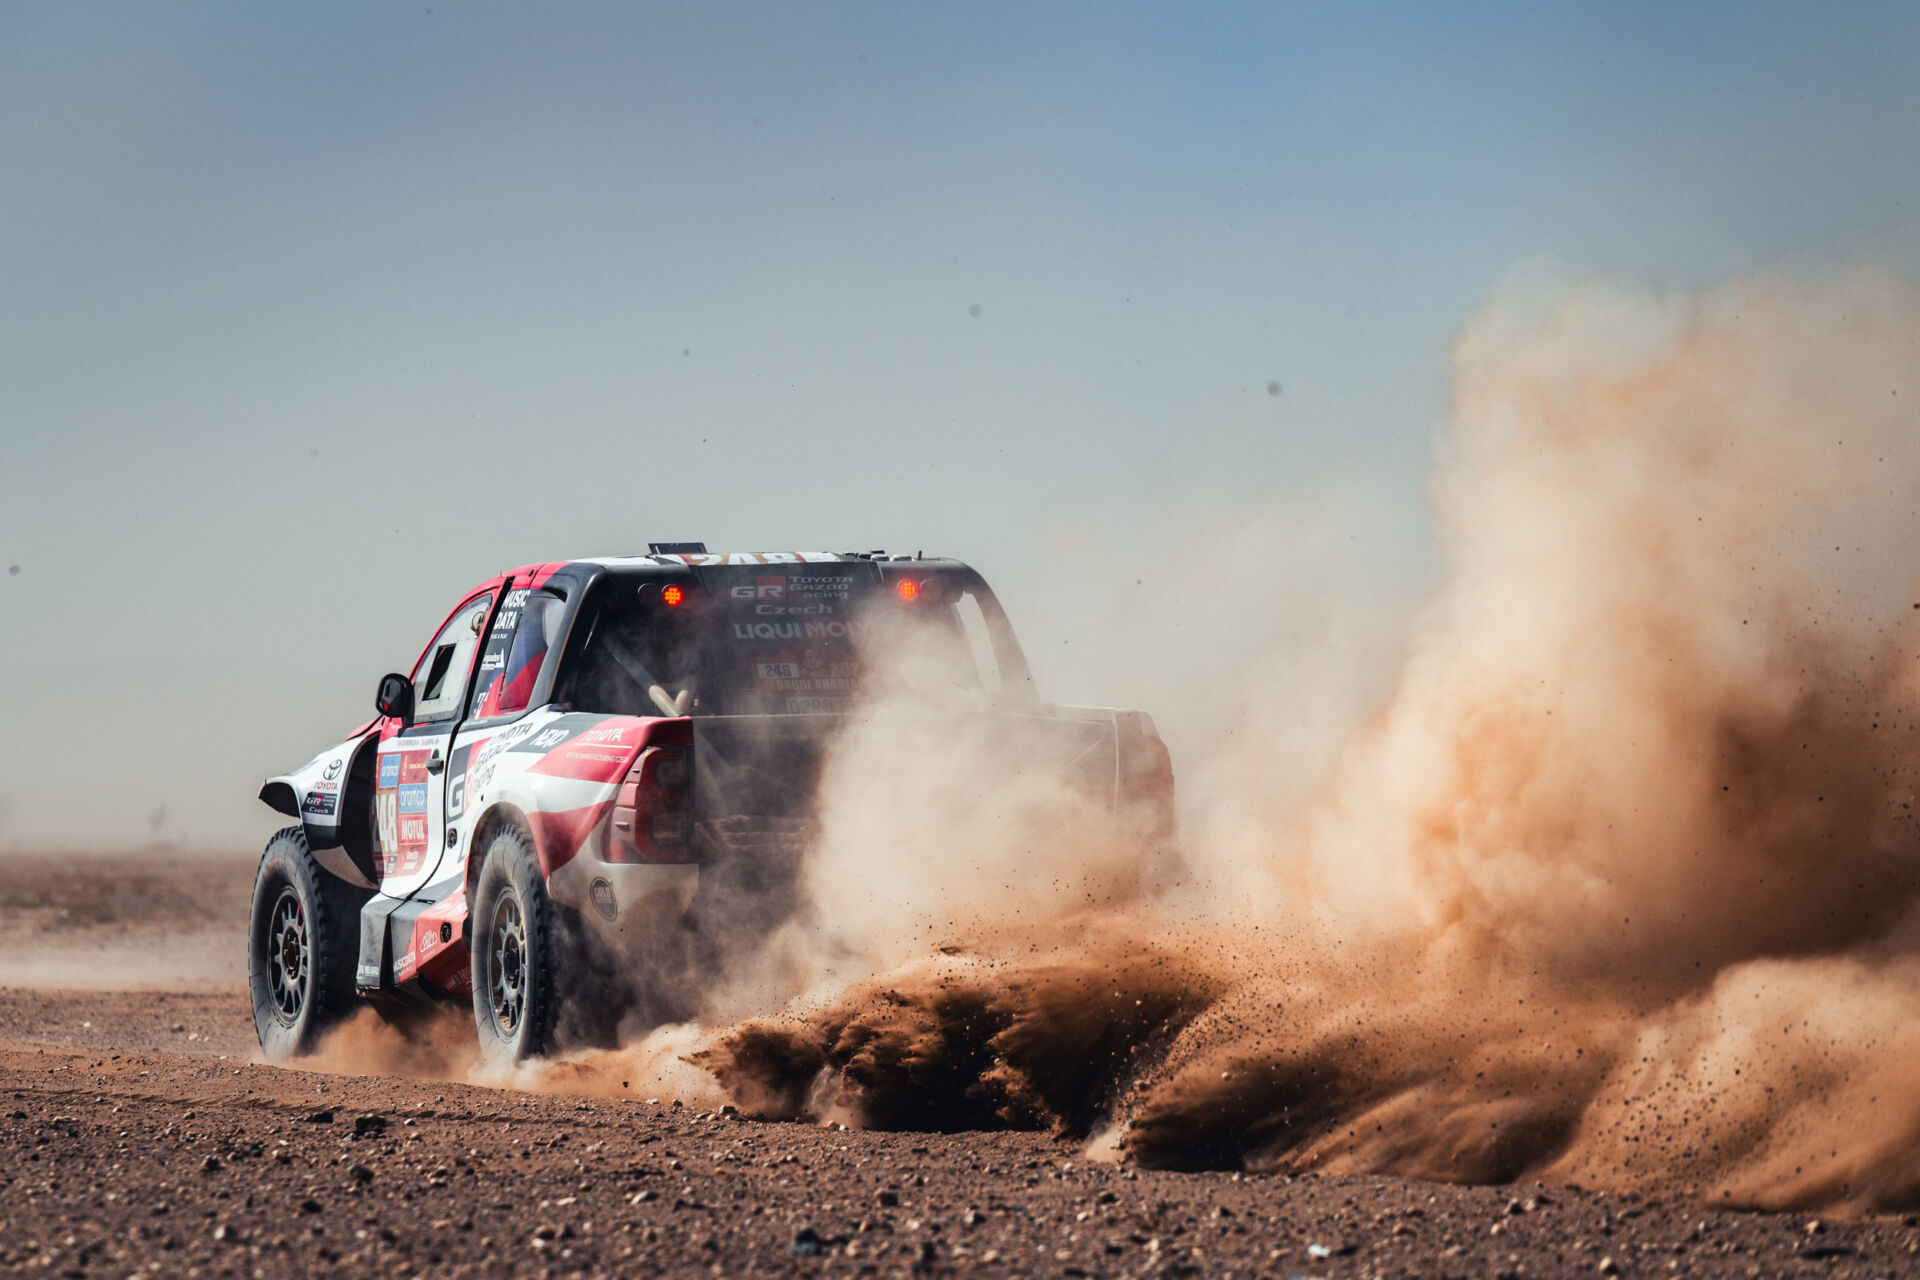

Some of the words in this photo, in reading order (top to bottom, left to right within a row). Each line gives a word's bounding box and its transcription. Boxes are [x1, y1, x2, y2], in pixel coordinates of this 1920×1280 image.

[731, 585, 782, 598] GR
[501, 589, 531, 609] MUSIC
[755, 603, 833, 616] Czech
[493, 610, 518, 631] DATA
[734, 622, 800, 640] LIQUI
[804, 620, 869, 637] MOLY
[763, 664, 792, 678] 248
[776, 679, 812, 691] SAUDI
[581, 727, 624, 742] TOYOTA
[314, 781, 338, 791] TOYOTA
[306, 797, 322, 806] GR
[400, 789, 425, 807] aramco
[401, 819, 425, 841] MOTUL
